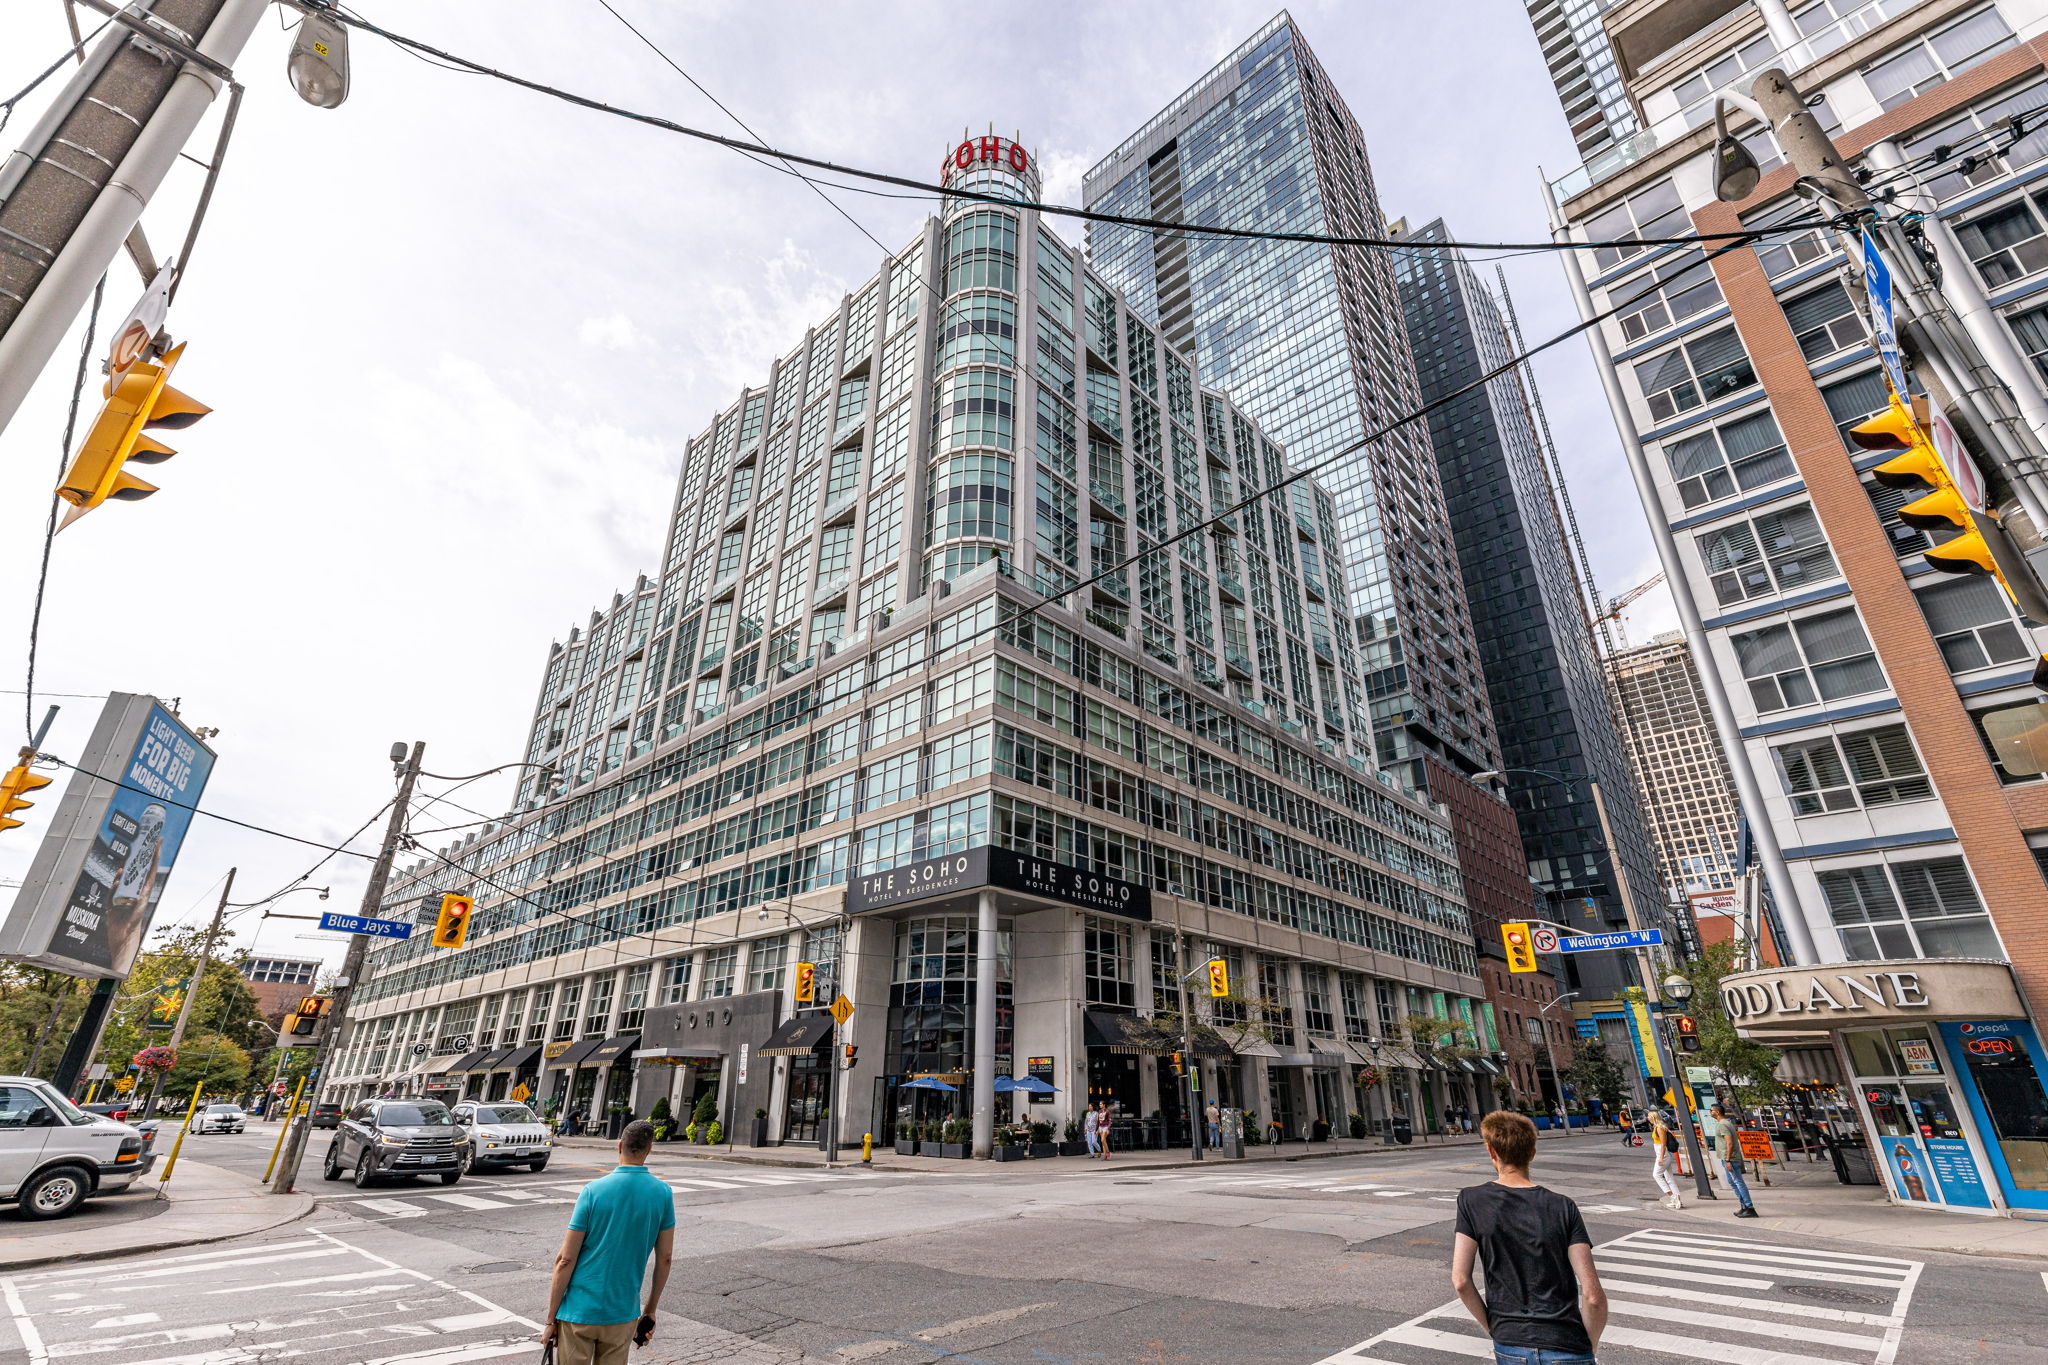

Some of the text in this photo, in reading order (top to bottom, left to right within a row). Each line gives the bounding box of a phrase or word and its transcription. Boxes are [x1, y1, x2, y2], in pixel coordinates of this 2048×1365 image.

[940, 136, 1027, 188] SOHO
[149, 715, 197, 765] LIGHT BEER
[138, 734, 192, 792] FOR BIG
[129, 761, 174, 801] MOMENTS
[862, 856, 968, 896] THE SOHO
[1017, 858, 1130, 901] THE SOHO
[868, 892, 893, 903] HOTEL
[906, 877, 959, 895] RESIDENCES
[1025, 879, 1055, 893] HOTEL
[1071, 890, 1124, 909] RESIDENCES
[1712, 895, 1734, 903] Hilton
[421, 906, 440, 914] PHASE
[424, 899, 442, 907] THREE
[1700, 900, 1733, 909] Garden
[65, 904, 101, 931] MUSKOKA
[327, 914, 406, 935] Blue Jays Wy
[1567, 934, 1629, 949] Wellington
[1639, 931, 1650, 942] W
[673, 1008, 733, 1031] SOHO
[1977, 1023, 2010, 1034] pepsi
[1907, 1046, 1930, 1060] ABM
[1968, 1040, 2013, 1053] OPEN
